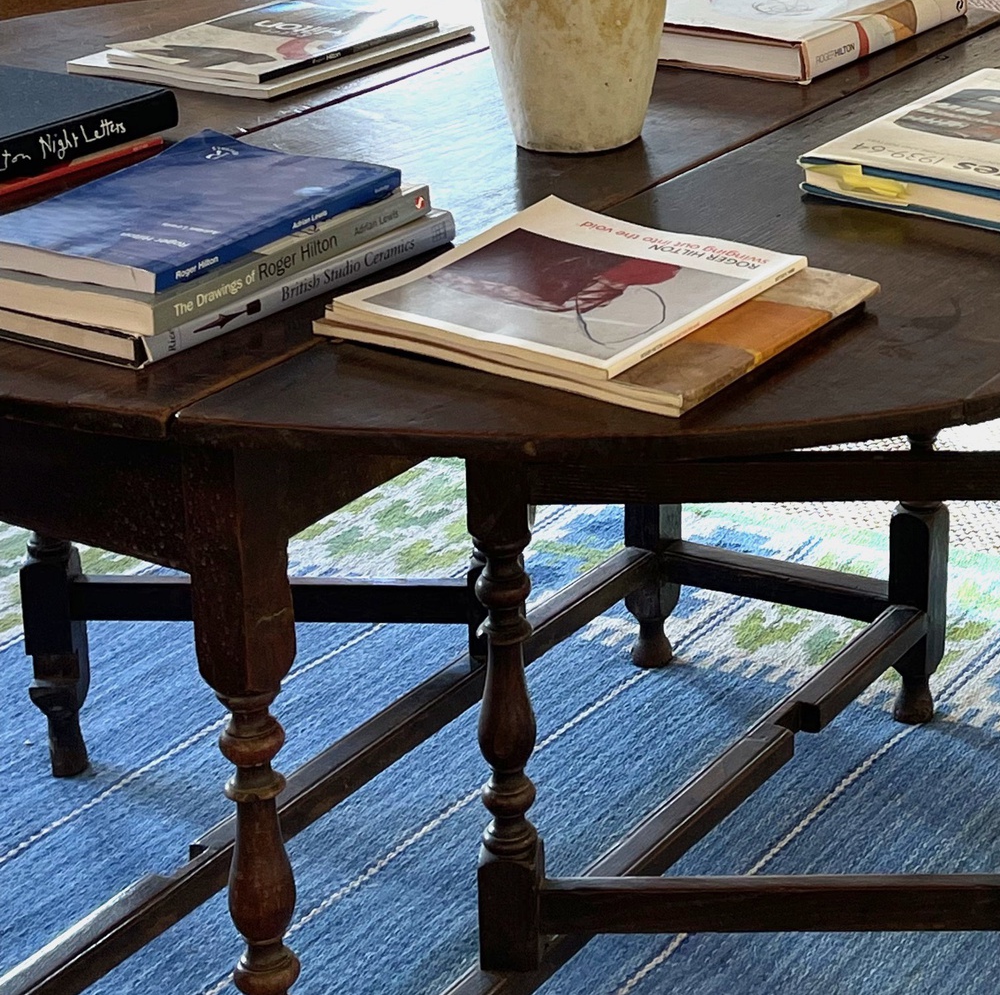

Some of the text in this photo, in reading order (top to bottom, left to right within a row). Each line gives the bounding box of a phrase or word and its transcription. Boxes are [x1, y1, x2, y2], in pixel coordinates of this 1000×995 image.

[39, 128, 79, 160] Night
[80, 118, 127, 143] Letters
[852, 142, 945, 164] 1939-64
[311, 210, 328, 222] Lewis
[354, 209, 400, 236] Adrian Lewis
[580, 220, 769, 265] swinging out into the void
[175, 256, 219, 280] Roger Hilton
[281, 237, 415, 302] British Studio Ceramics
[648, 244, 760, 270] ROGER HILTON
[173, 235, 338, 317] The Drawings of Roger Hilton
